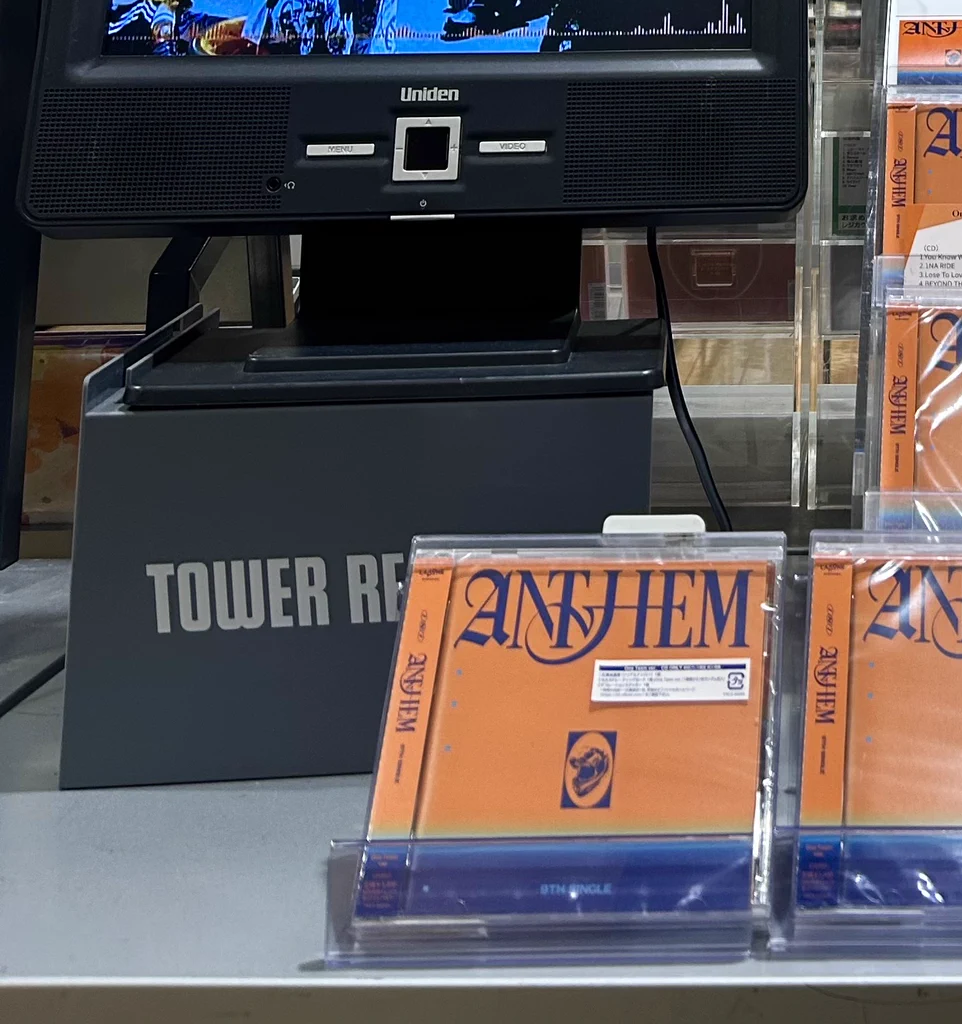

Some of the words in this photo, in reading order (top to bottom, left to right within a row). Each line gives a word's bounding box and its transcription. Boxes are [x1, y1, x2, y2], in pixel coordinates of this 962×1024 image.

[400, 87, 460, 102] Uniden
[328, 145, 354, 154] MENU
[499, 142, 526, 150] VIDEO
[146, 556, 330, 634] TOWER
[454, 568, 754, 665] ANTHEM
